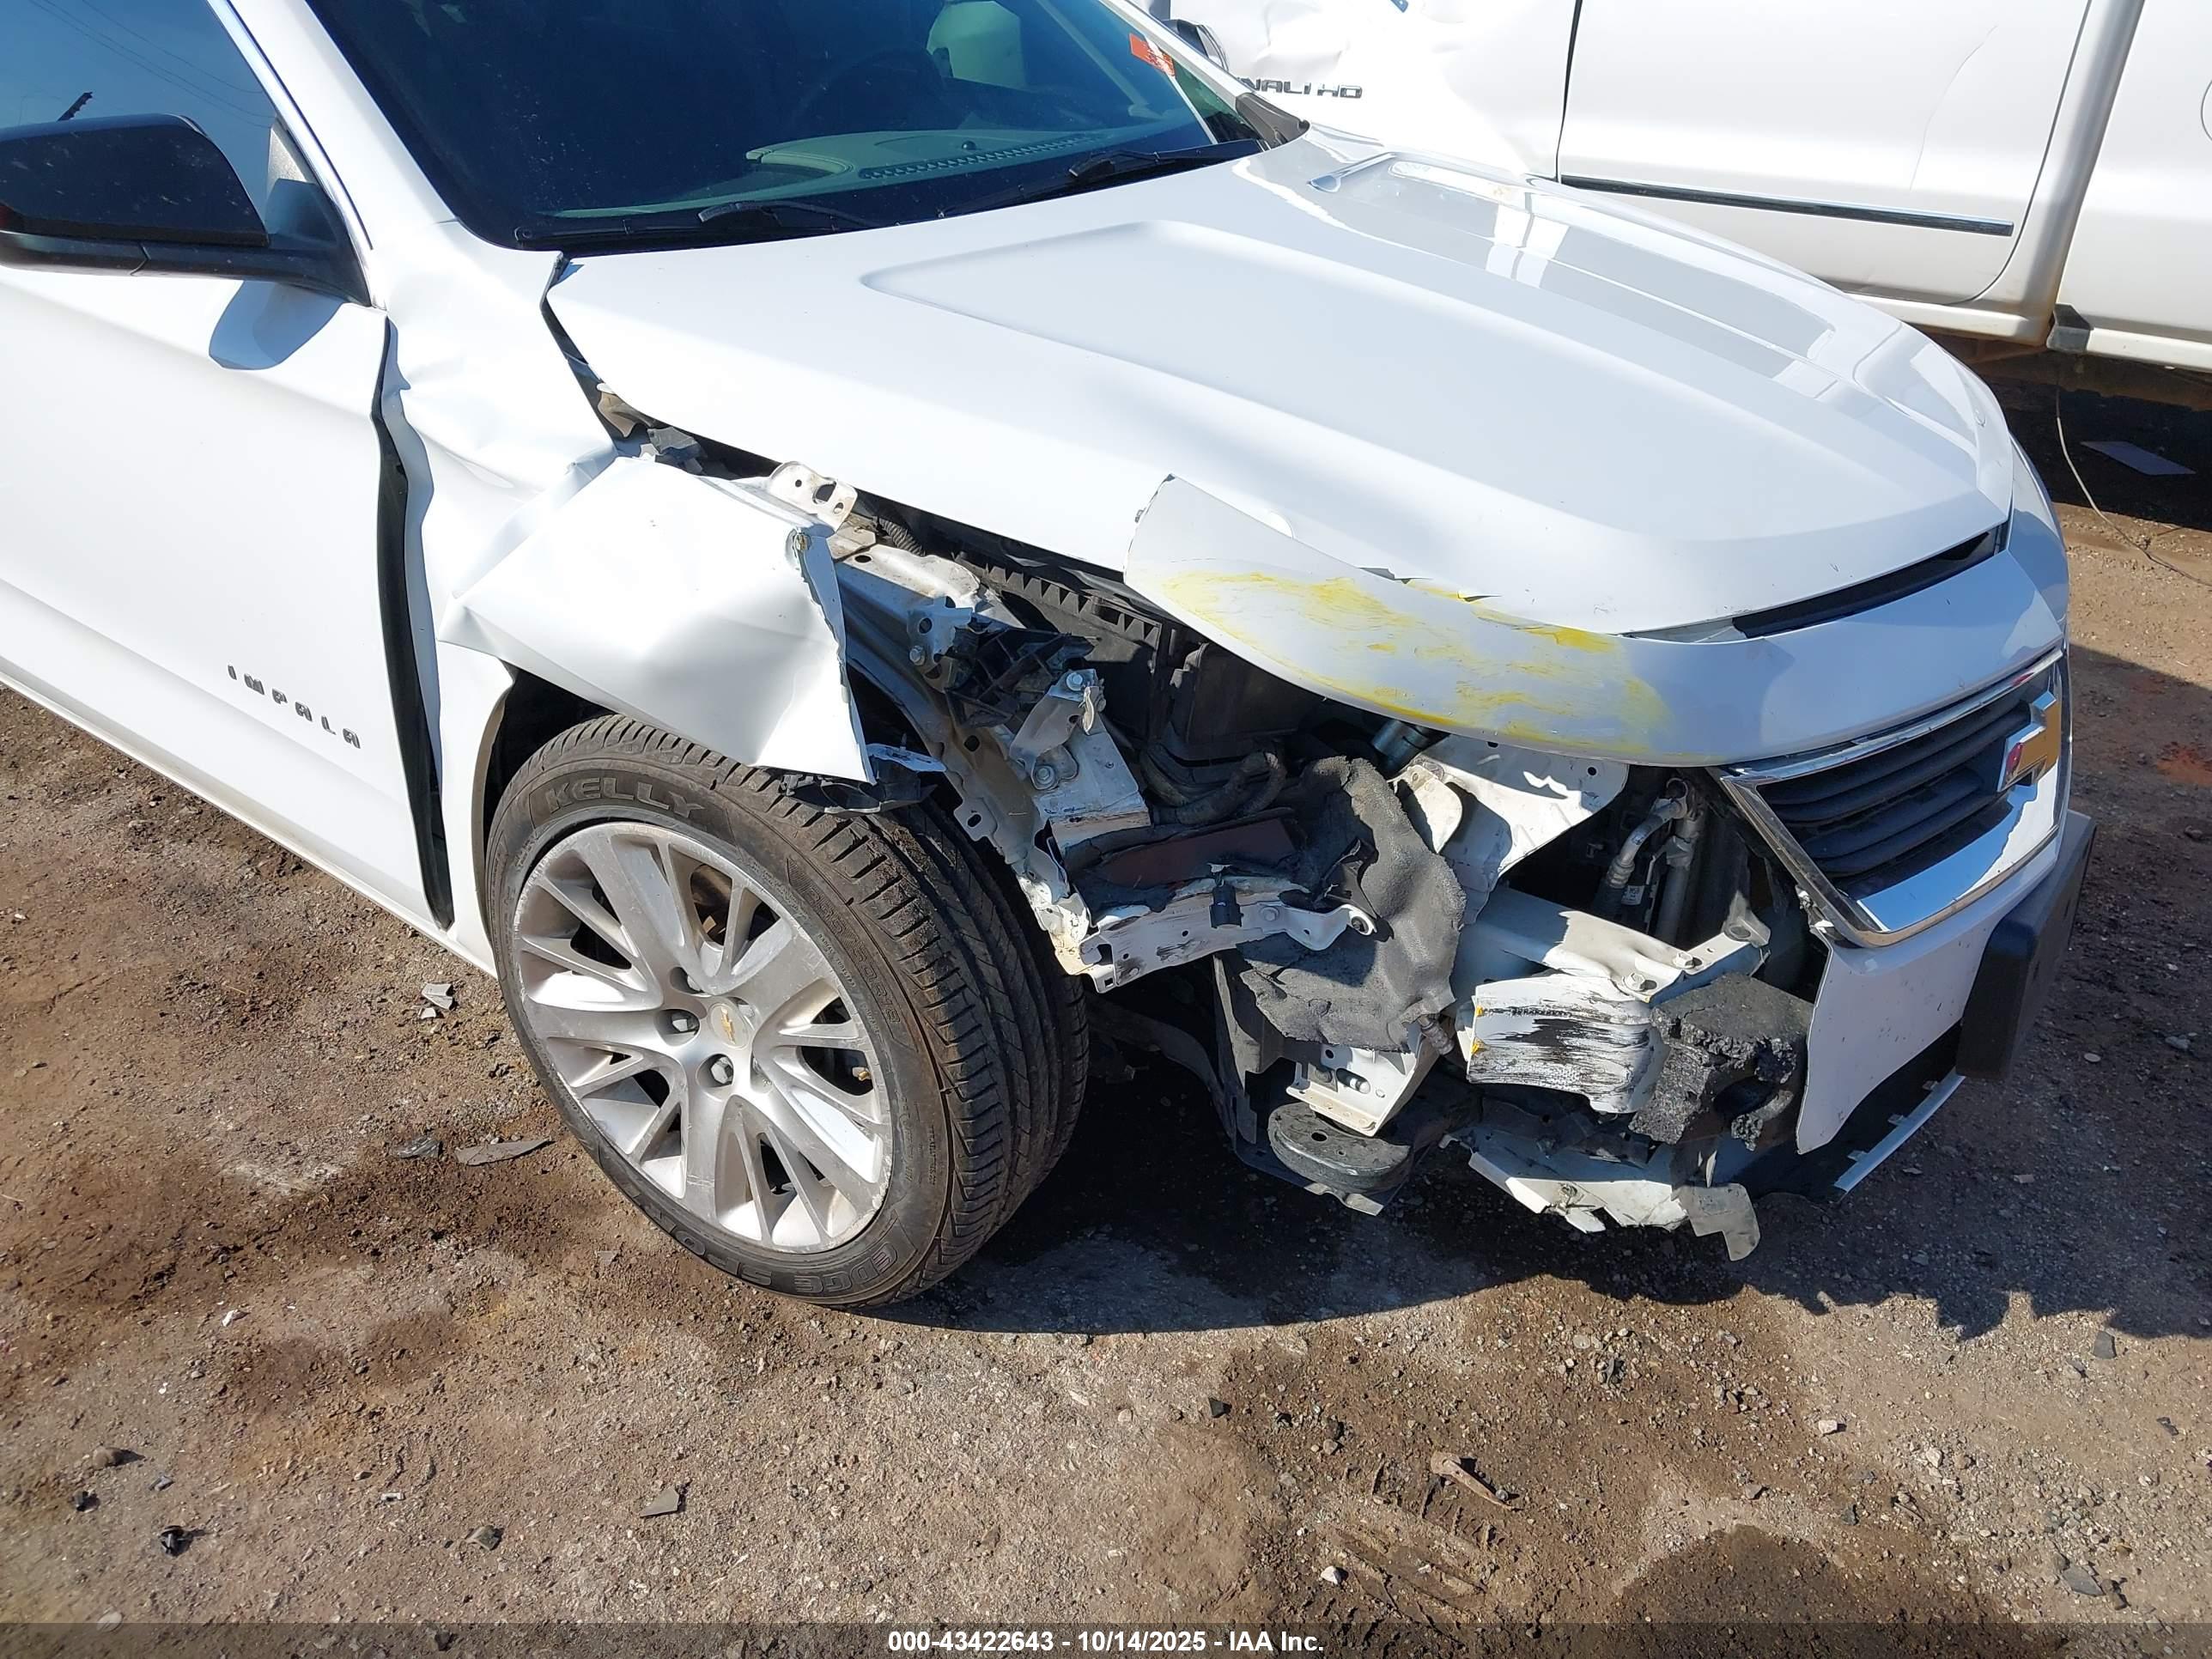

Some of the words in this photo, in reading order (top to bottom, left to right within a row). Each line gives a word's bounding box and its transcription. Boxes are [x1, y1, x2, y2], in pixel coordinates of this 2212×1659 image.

[1237, 76, 1312, 94] NALI
[1316, 83, 1363, 99] HD
[227, 664, 362, 750] IMPALA
[545, 777, 705, 818] KELLY
[793, 1243, 898, 1293] EDGE
